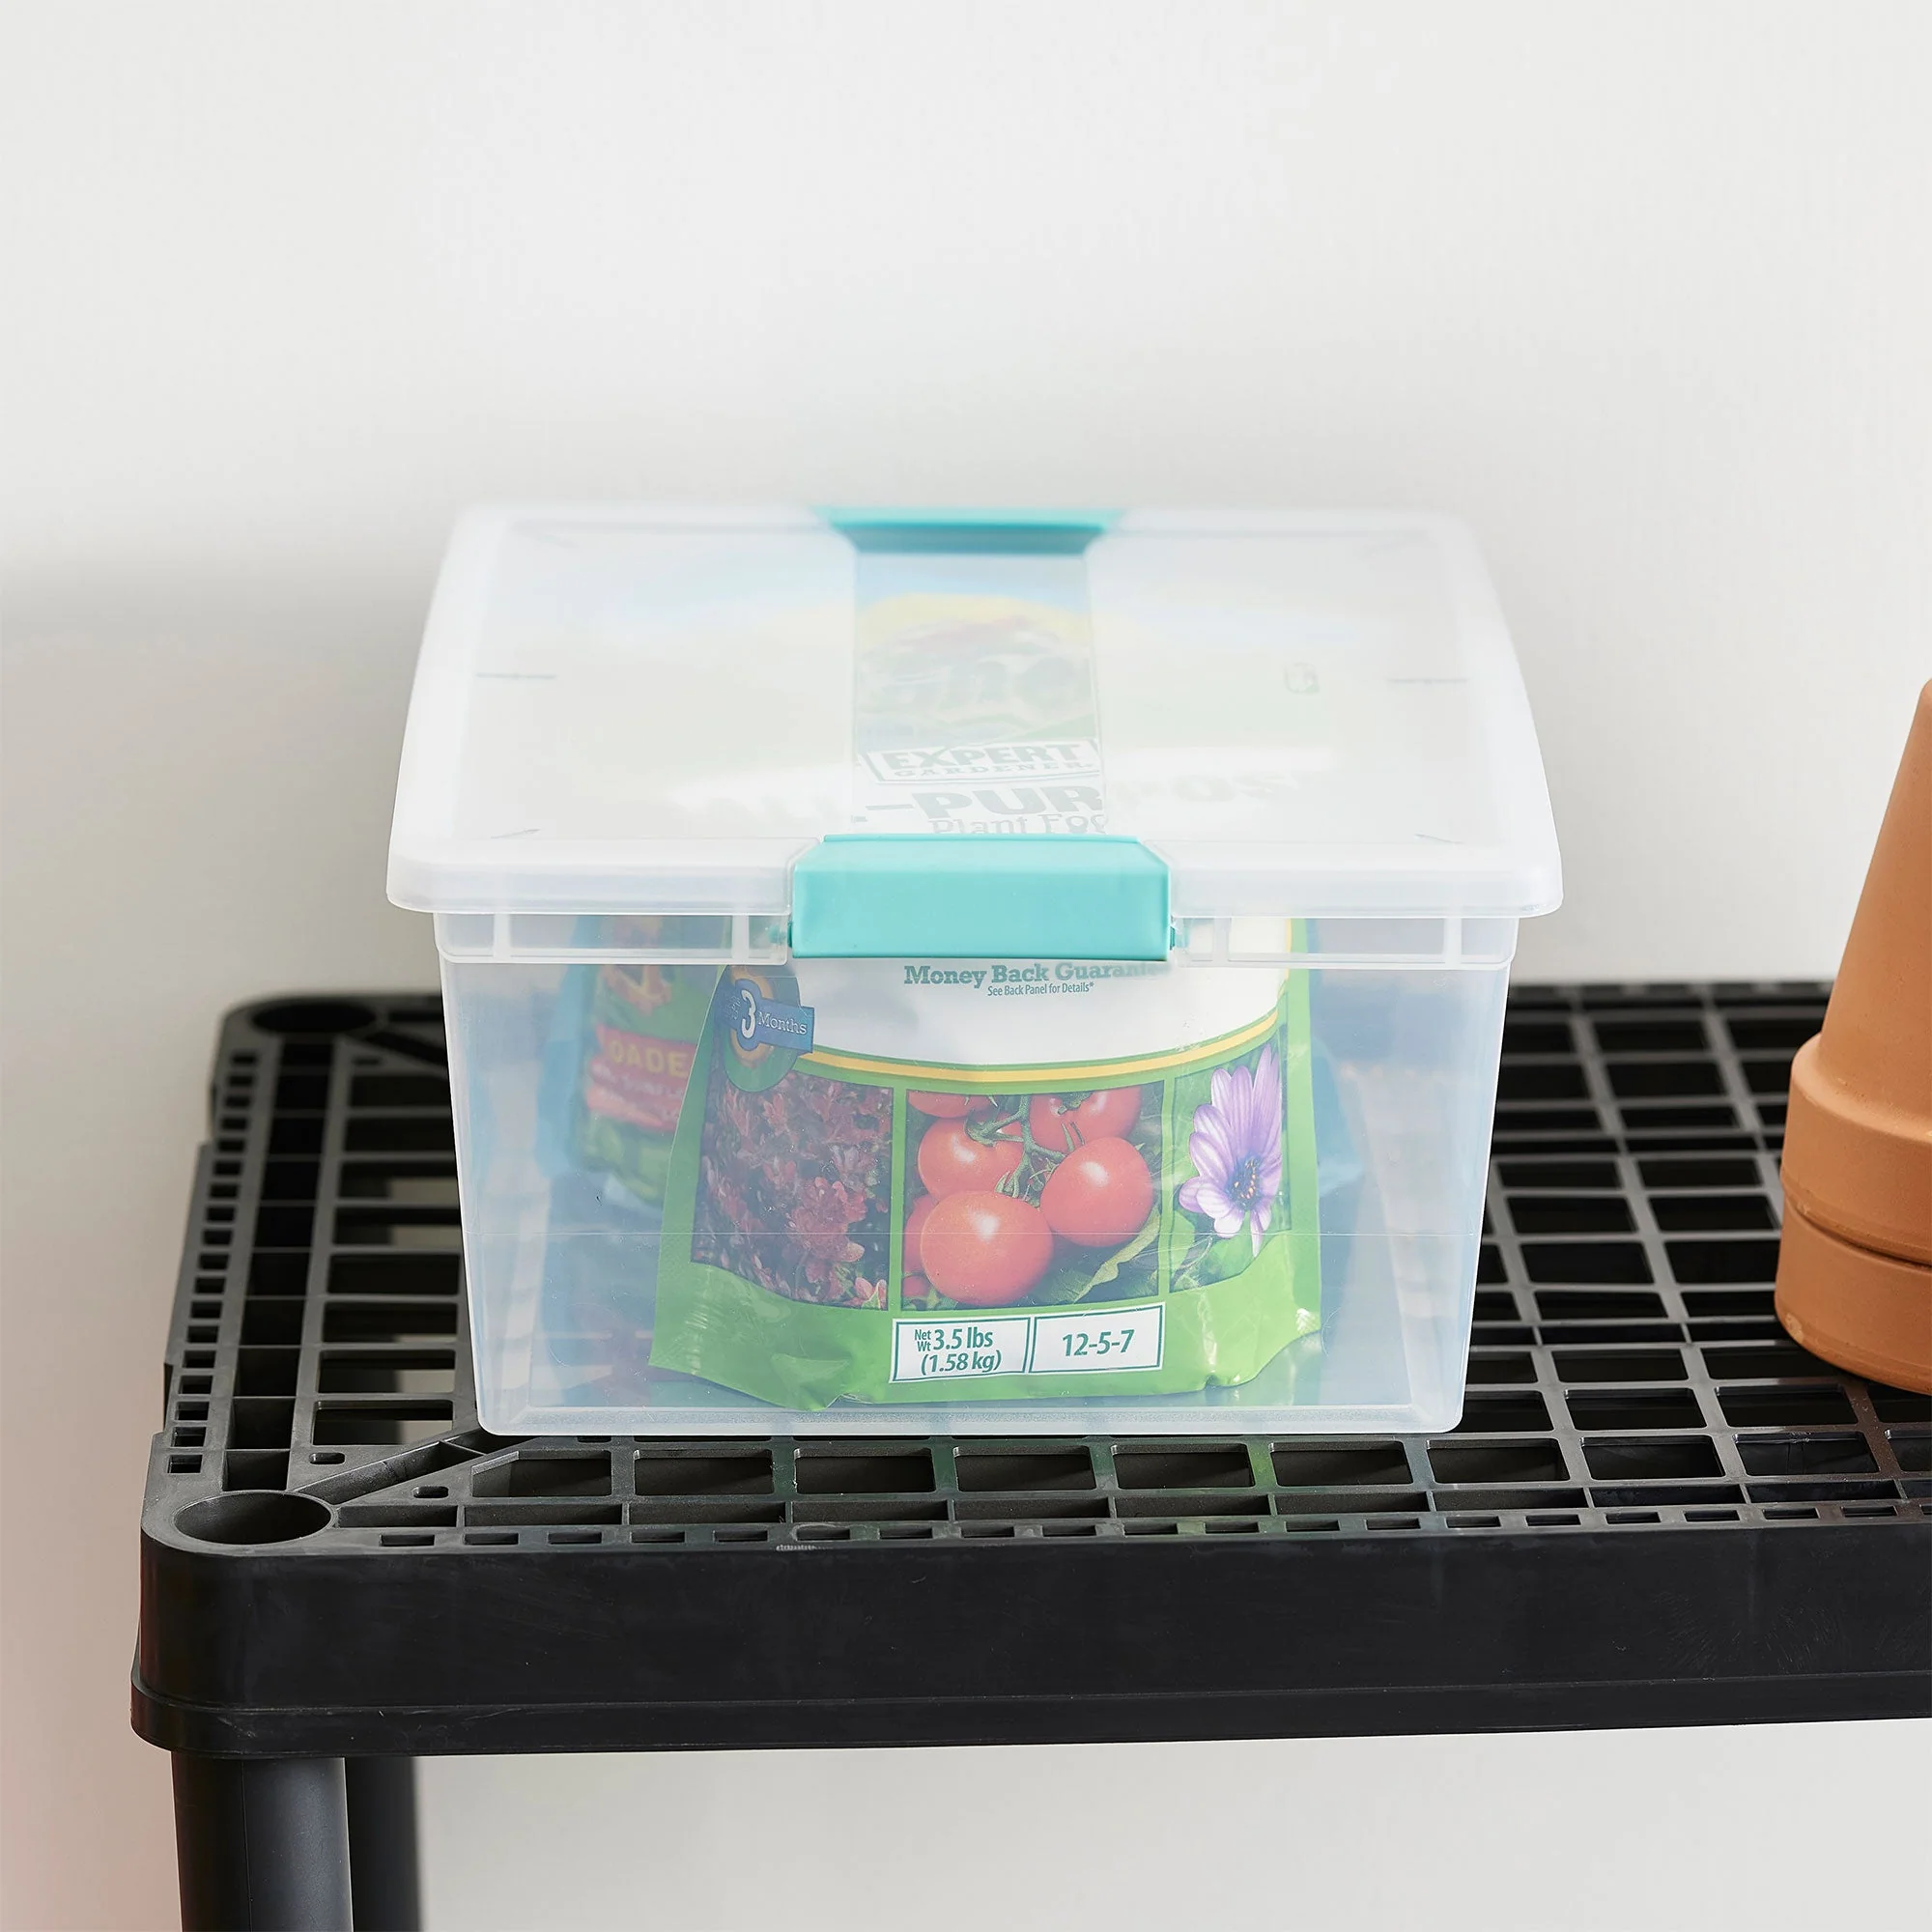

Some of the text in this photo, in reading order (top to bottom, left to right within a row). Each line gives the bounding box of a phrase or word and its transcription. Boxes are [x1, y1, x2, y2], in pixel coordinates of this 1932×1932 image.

[881, 744, 1080, 770] EXPERT
[894, 760, 1085, 777] GARDENER
[903, 961, 1171, 989] Money Back Guarant
[987, 984, 1003, 996] See
[1004, 983, 1024, 996] Back
[1025, 982, 1048, 995] Panel
[1049, 982, 1061, 994] for
[741, 989, 756, 1038] 3
[757, 1011, 808, 1035] Months
[914, 1326, 994, 1351] Net 3.5 lbs
[917, 1340, 931, 1352] Wt
[1062, 1328, 1135, 1357] 12-5-7
[921, 1350, 1002, 1376] (1.58 kg)
